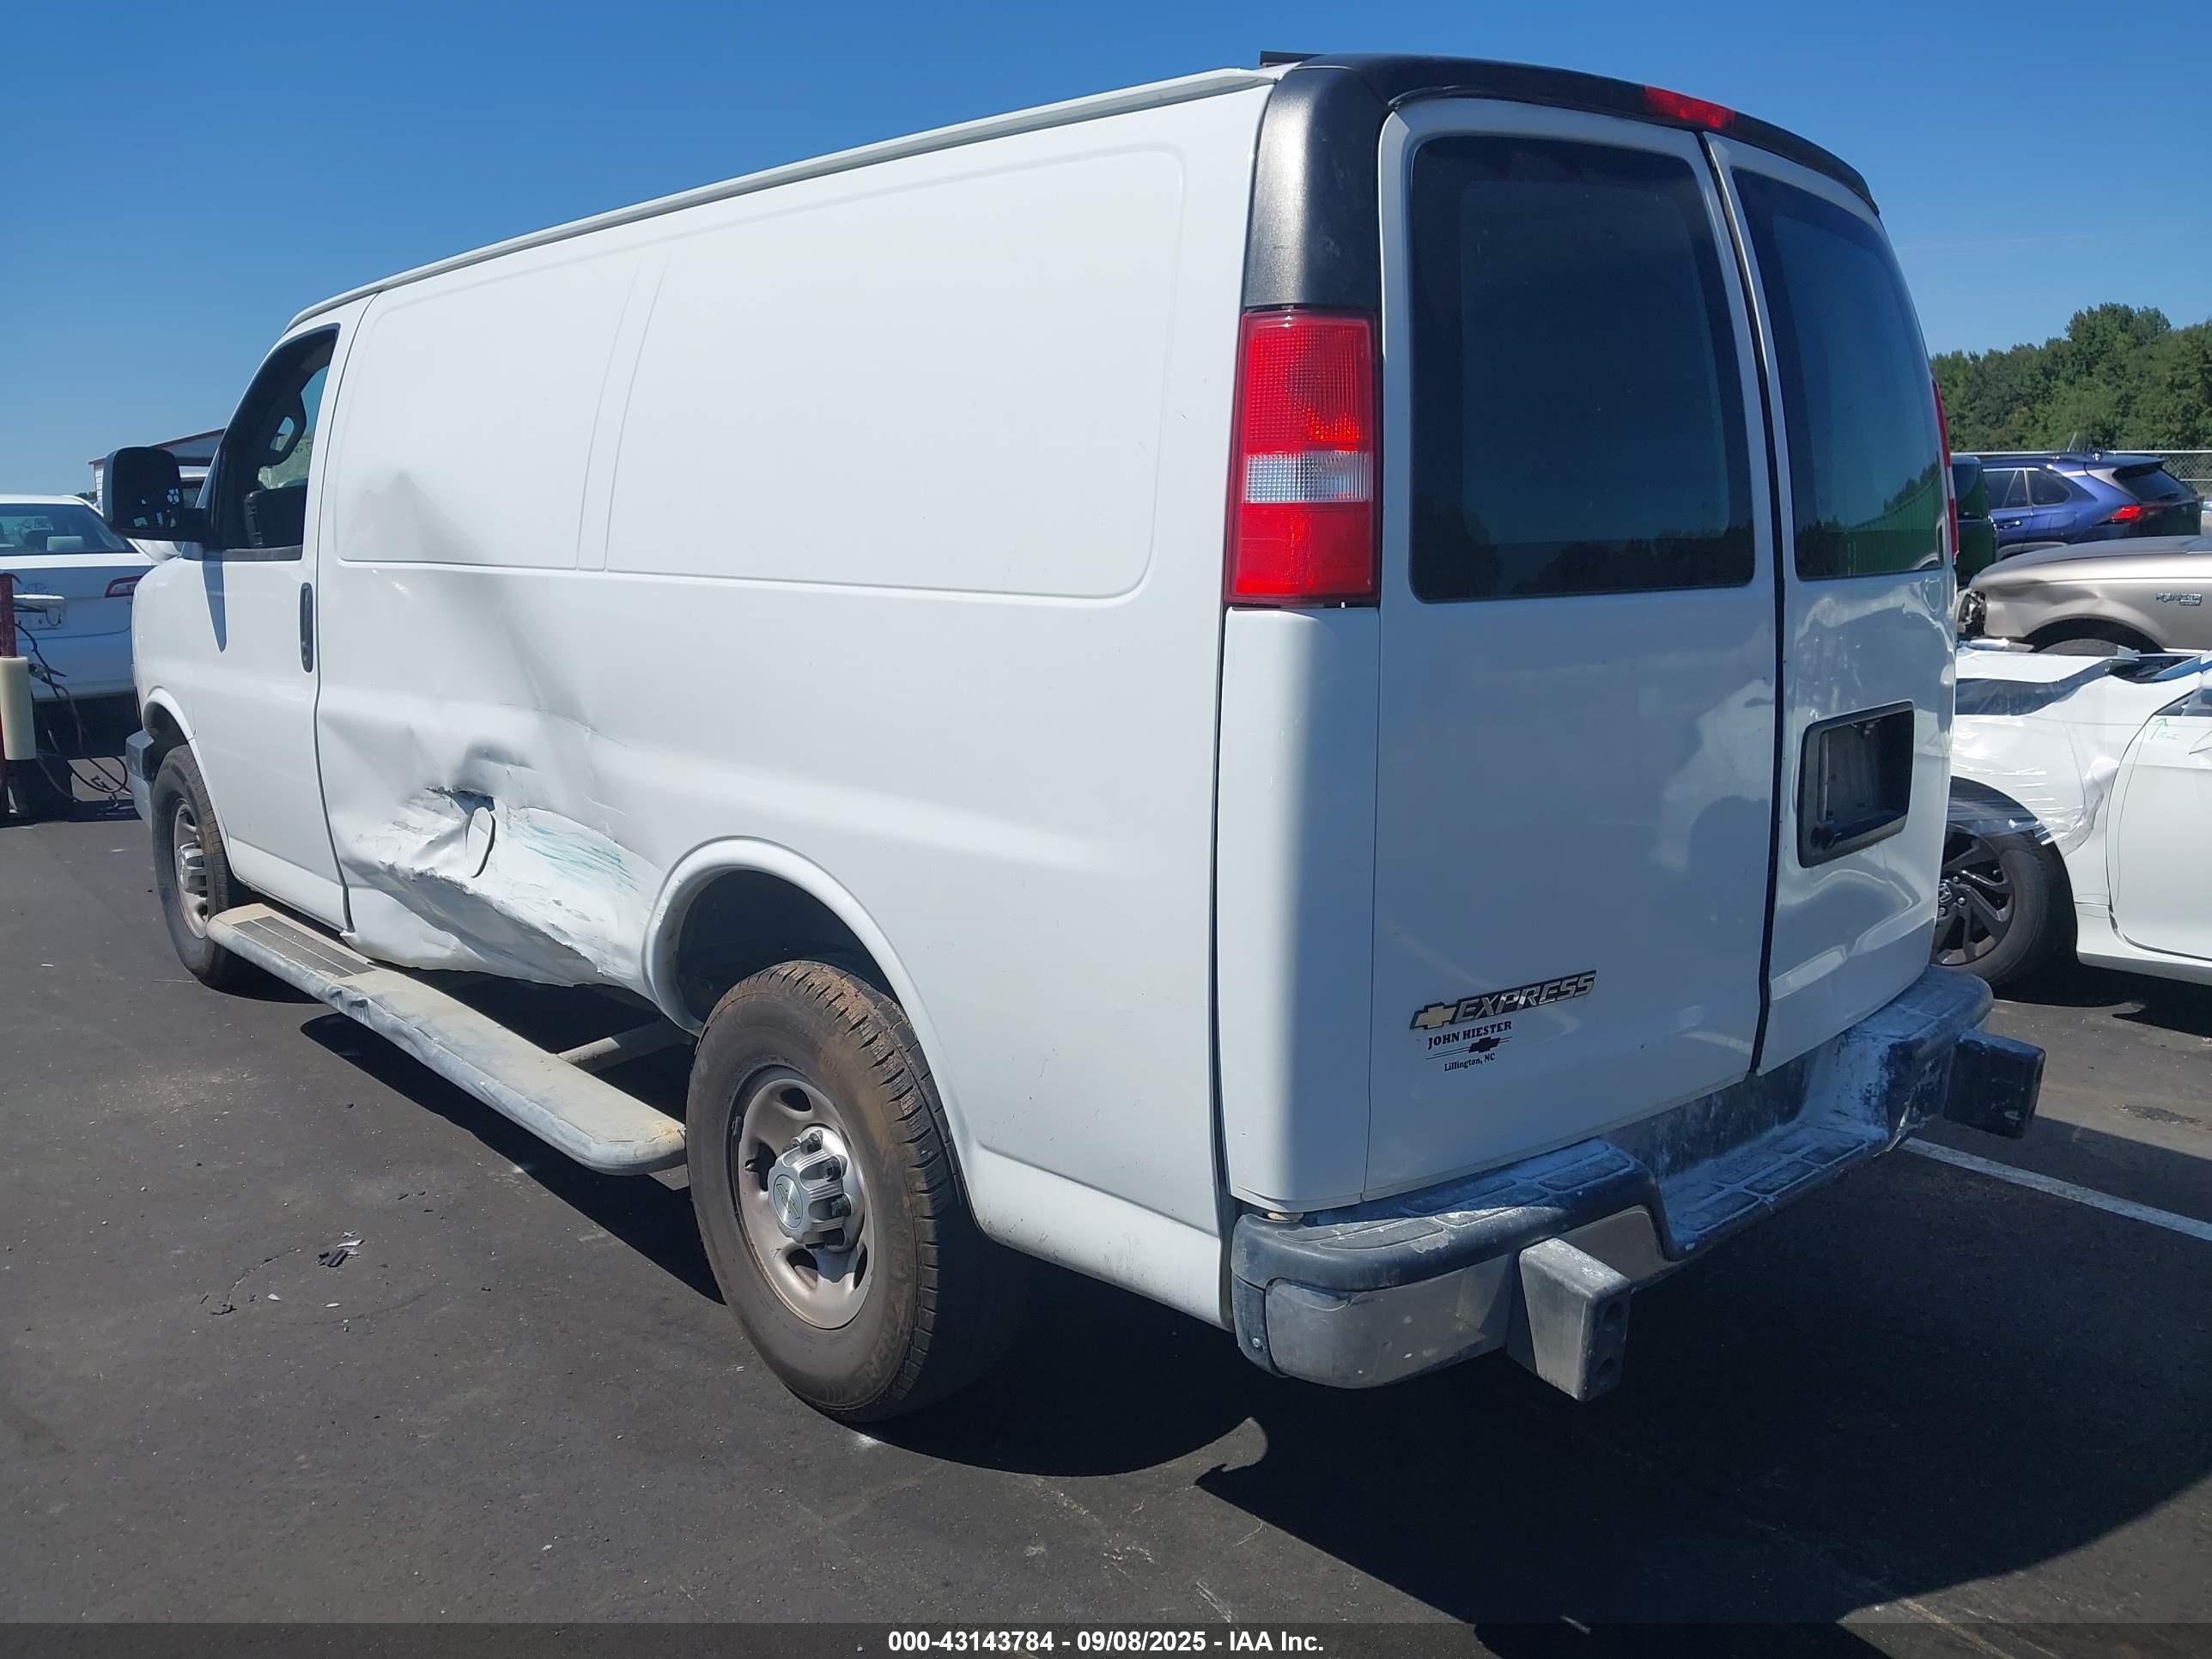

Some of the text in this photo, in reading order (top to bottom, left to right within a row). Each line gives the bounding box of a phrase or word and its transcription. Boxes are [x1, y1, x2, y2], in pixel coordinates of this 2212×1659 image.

[1454, 973, 1595, 1023] EXPRESS
[1428, 1020, 1512, 1049] JOHN HIESTER
[1444, 1053, 1496, 1072] Lillington, NC
